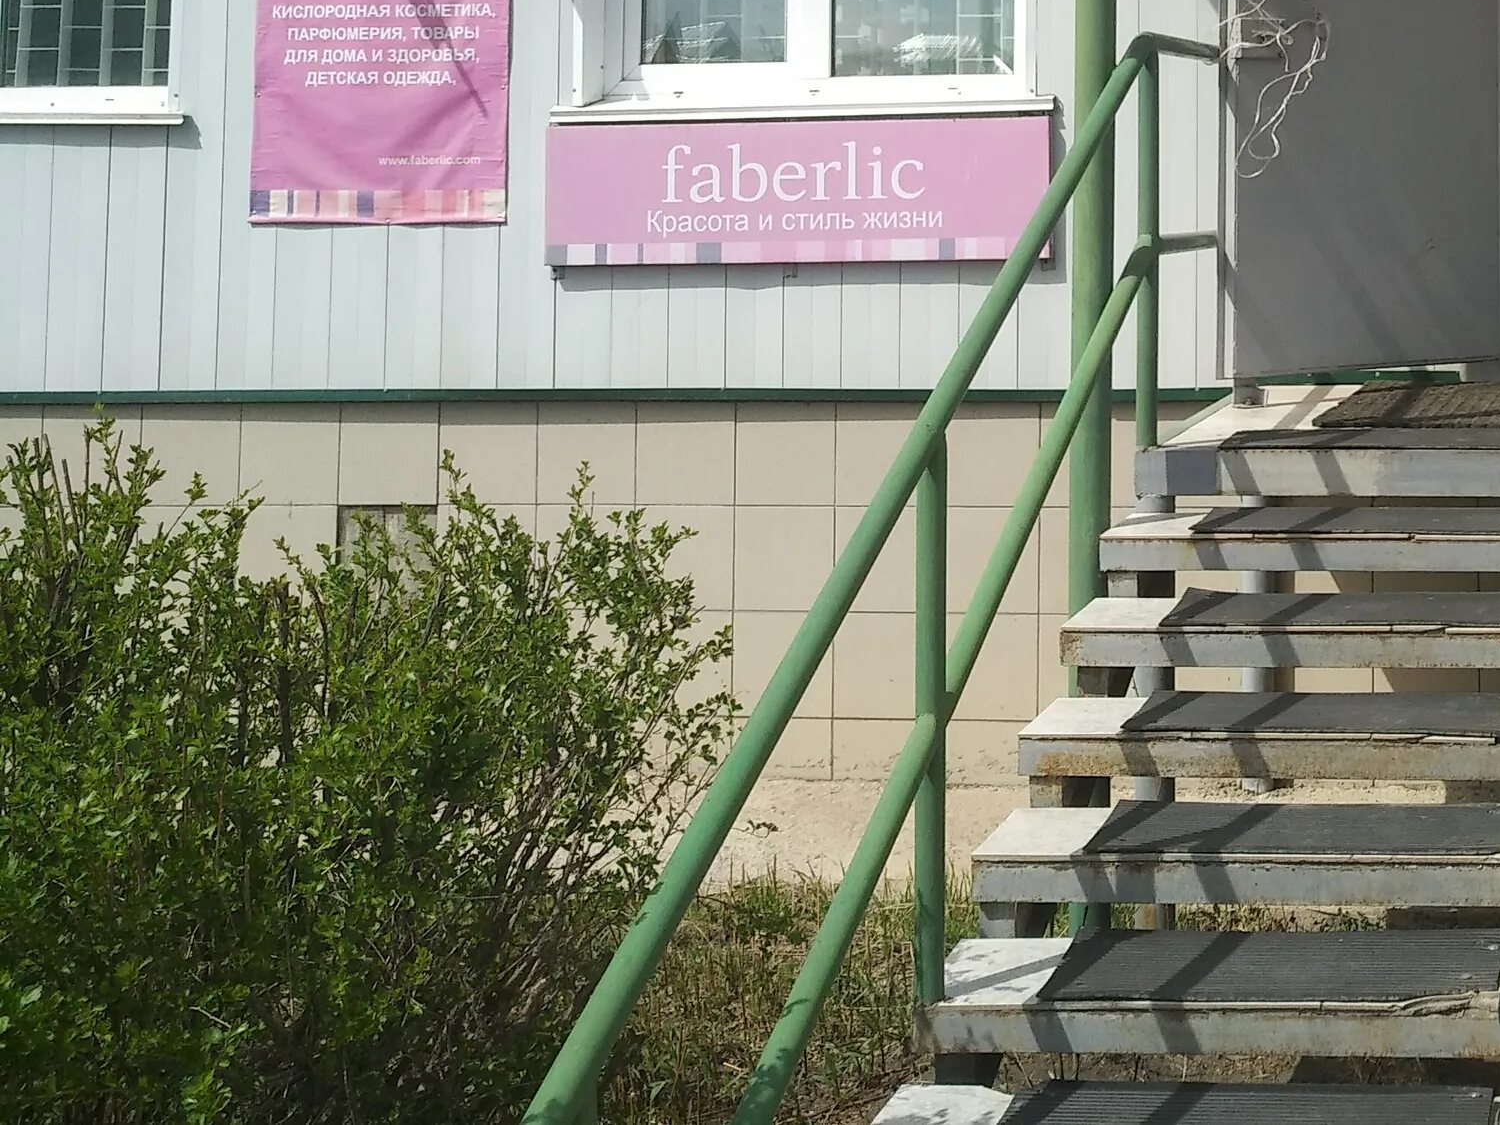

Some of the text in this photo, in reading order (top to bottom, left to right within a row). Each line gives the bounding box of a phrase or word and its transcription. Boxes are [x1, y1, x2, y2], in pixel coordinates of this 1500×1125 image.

[272, 2, 497, 20] КИСЛОРОДНАЯ КОСМЕТИКА,
[287, 25, 480, 43] ПАРФЮМЕРИЯ, ТОВАРЫ
[284, 48, 480, 66] ДЛЯ ДОМА И ЗДОРОВЬЯ,
[305, 71, 379, 87] ДЕТСКАЯ
[378, 155, 481, 165] www.faberlic.com
[661, 140, 926, 204] faberlic
[646, 209, 944, 238] Красота и стиль жизни
